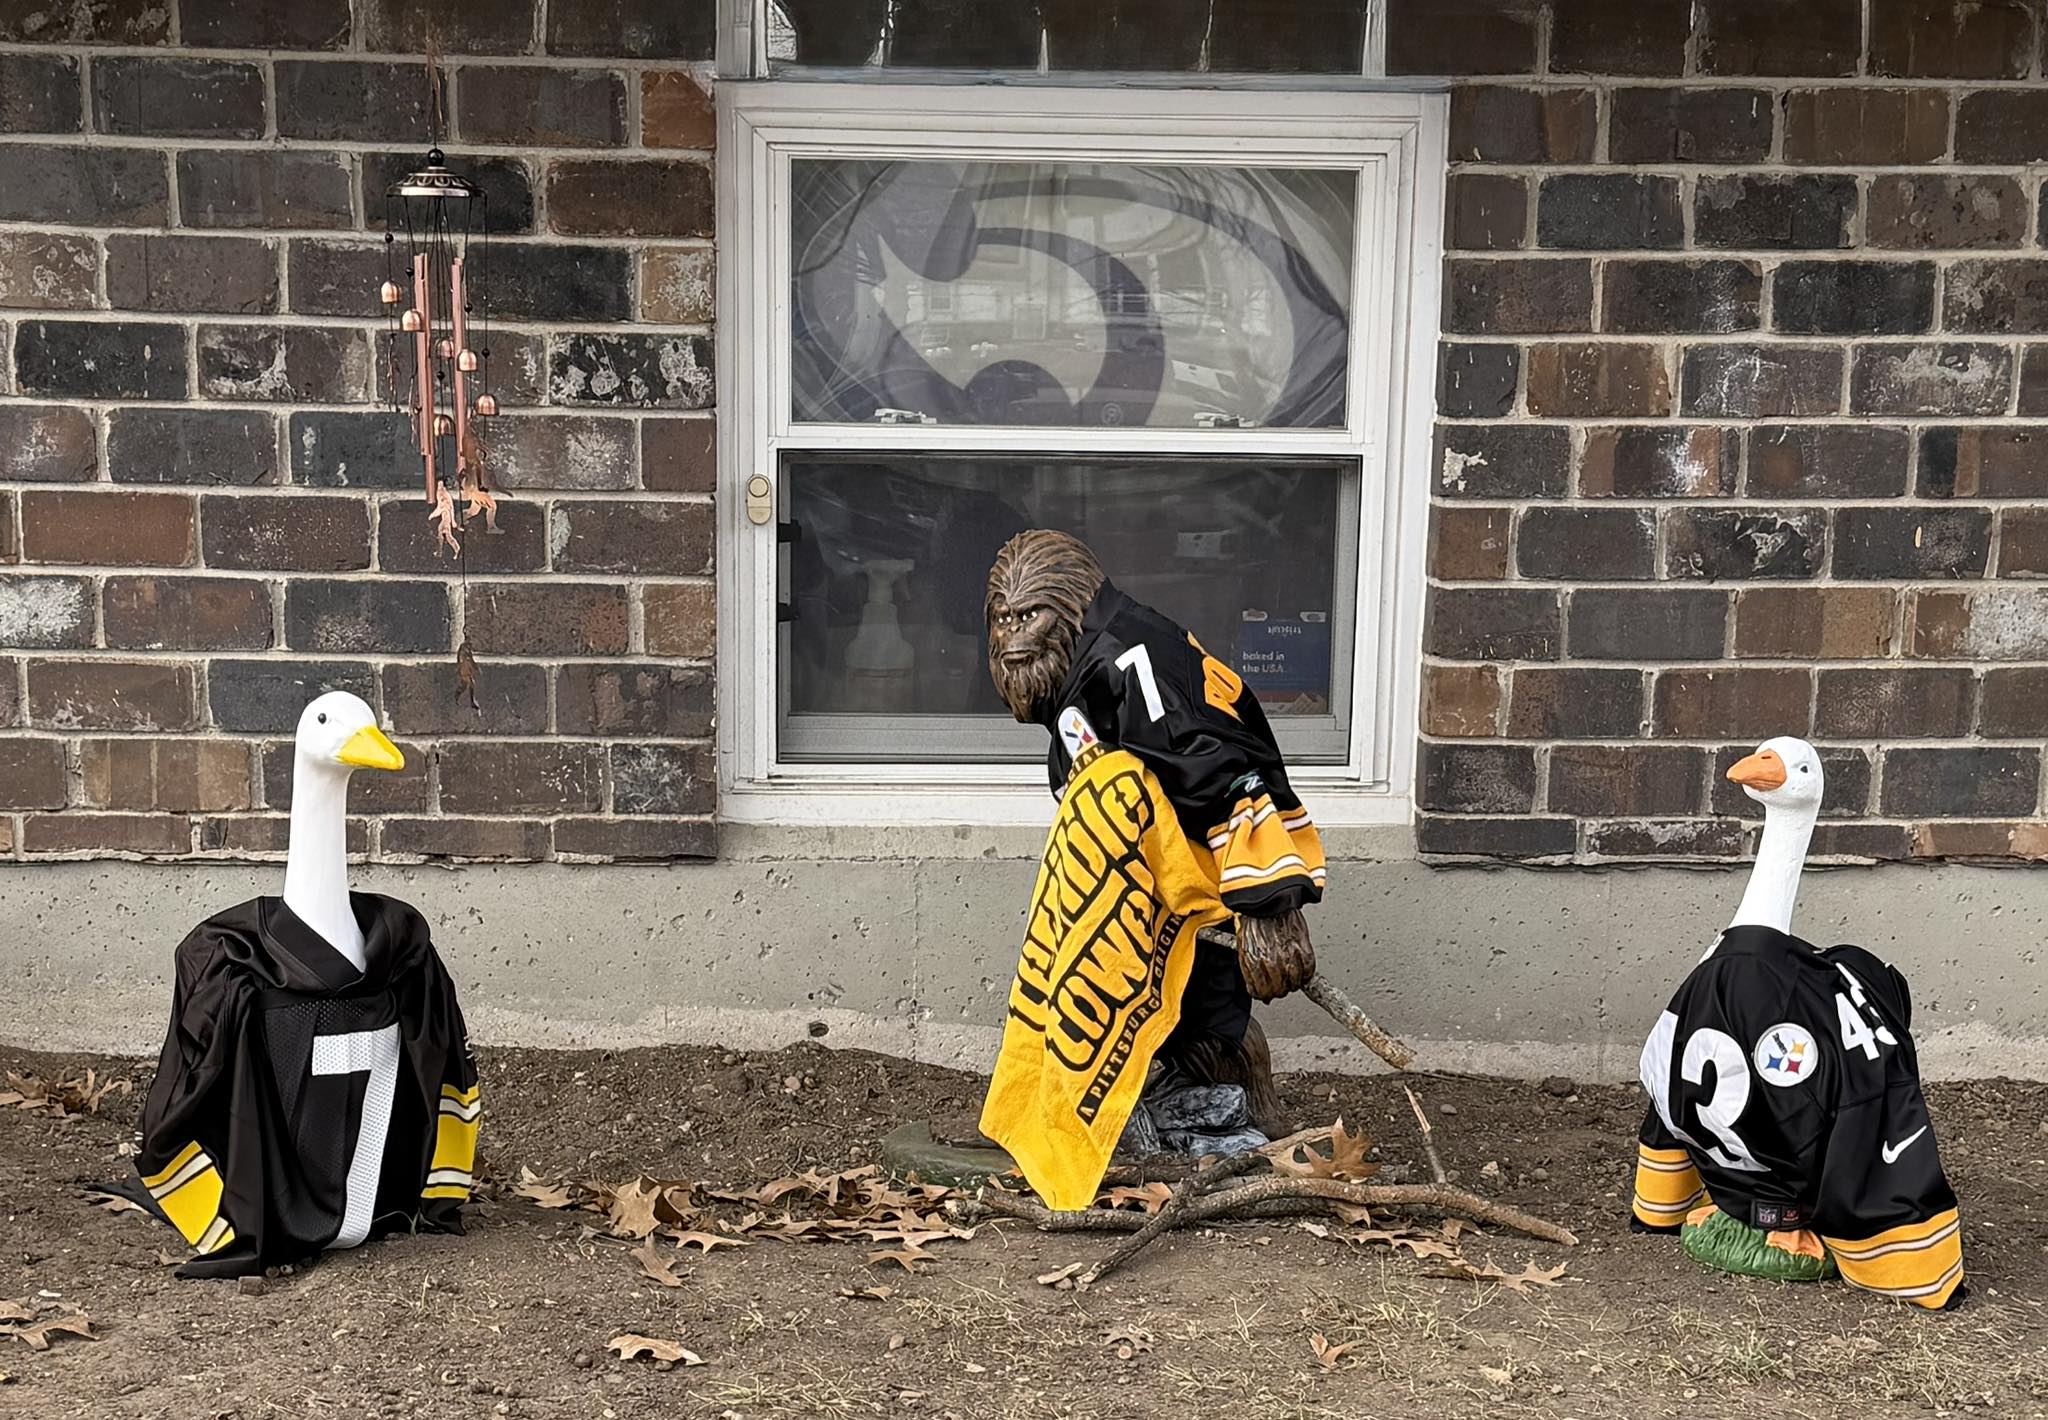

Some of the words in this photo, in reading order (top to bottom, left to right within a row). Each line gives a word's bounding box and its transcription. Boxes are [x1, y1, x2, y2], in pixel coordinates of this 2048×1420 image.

[1114, 643, 1165, 722] 7
[1243, 651, 1274, 661] baked
[1276, 651, 1285, 661] in
[1243, 664, 1260, 673] the
[1079, 1106, 1095, 1118] A
[1090, 986, 1161, 1100] PITTSBURGH
[1153, 914, 1183, 977] ORIGIN
[312, 1021, 401, 1250] 7
